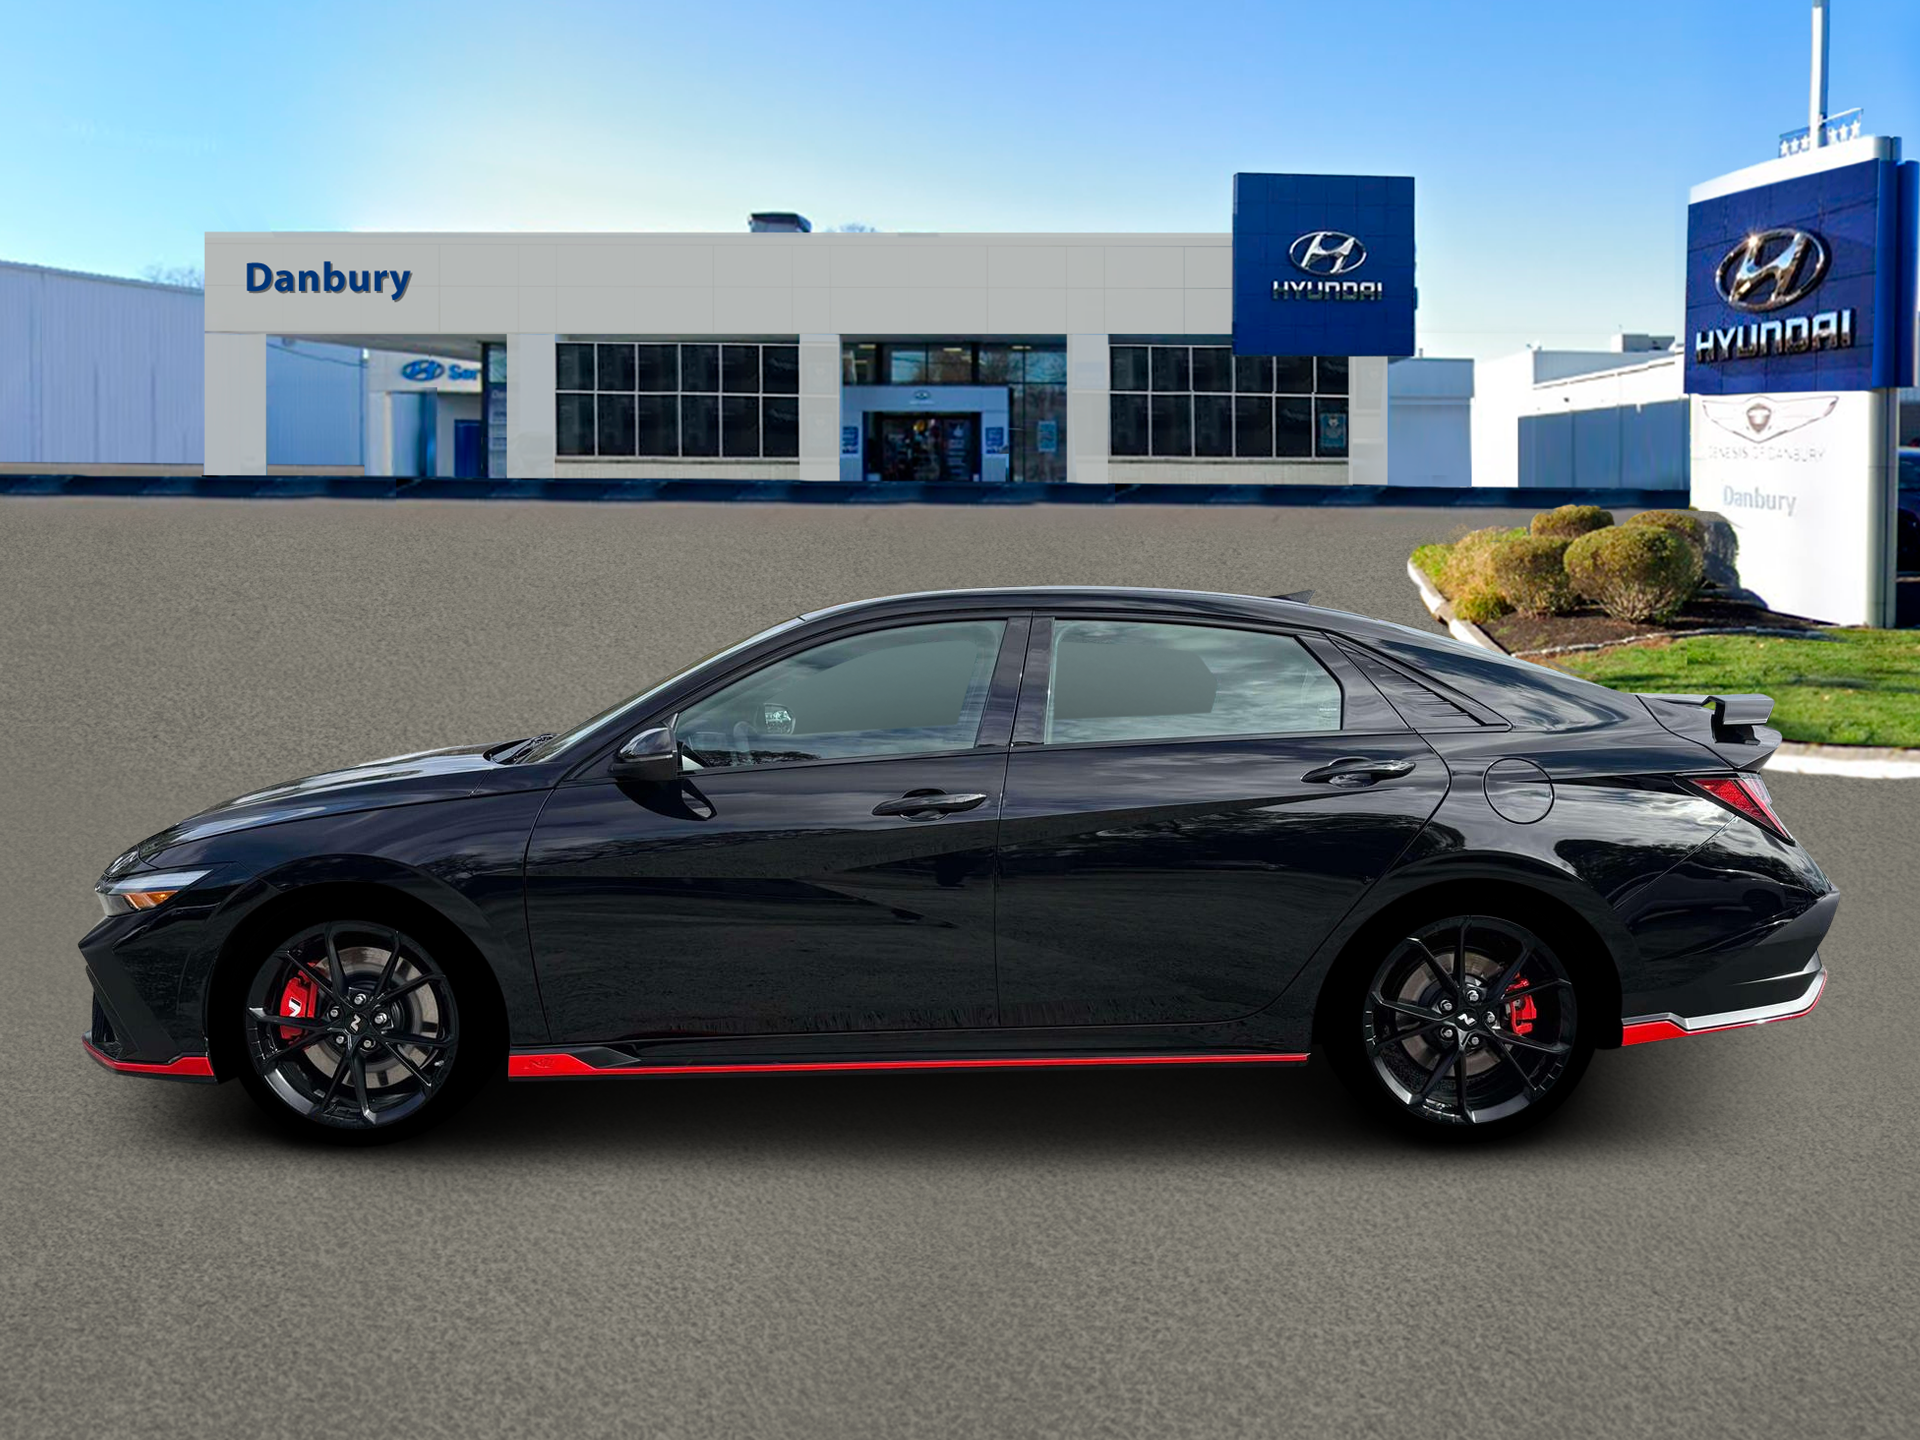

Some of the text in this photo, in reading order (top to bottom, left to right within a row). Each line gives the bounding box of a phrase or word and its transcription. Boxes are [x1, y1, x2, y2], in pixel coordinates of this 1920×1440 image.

[246, 261, 412, 302] Danbury
[1273, 281, 1383, 300] HYUNDAI
[1696, 309, 1853, 363] HYUNDAI
[1723, 485, 1797, 517] Danbury
